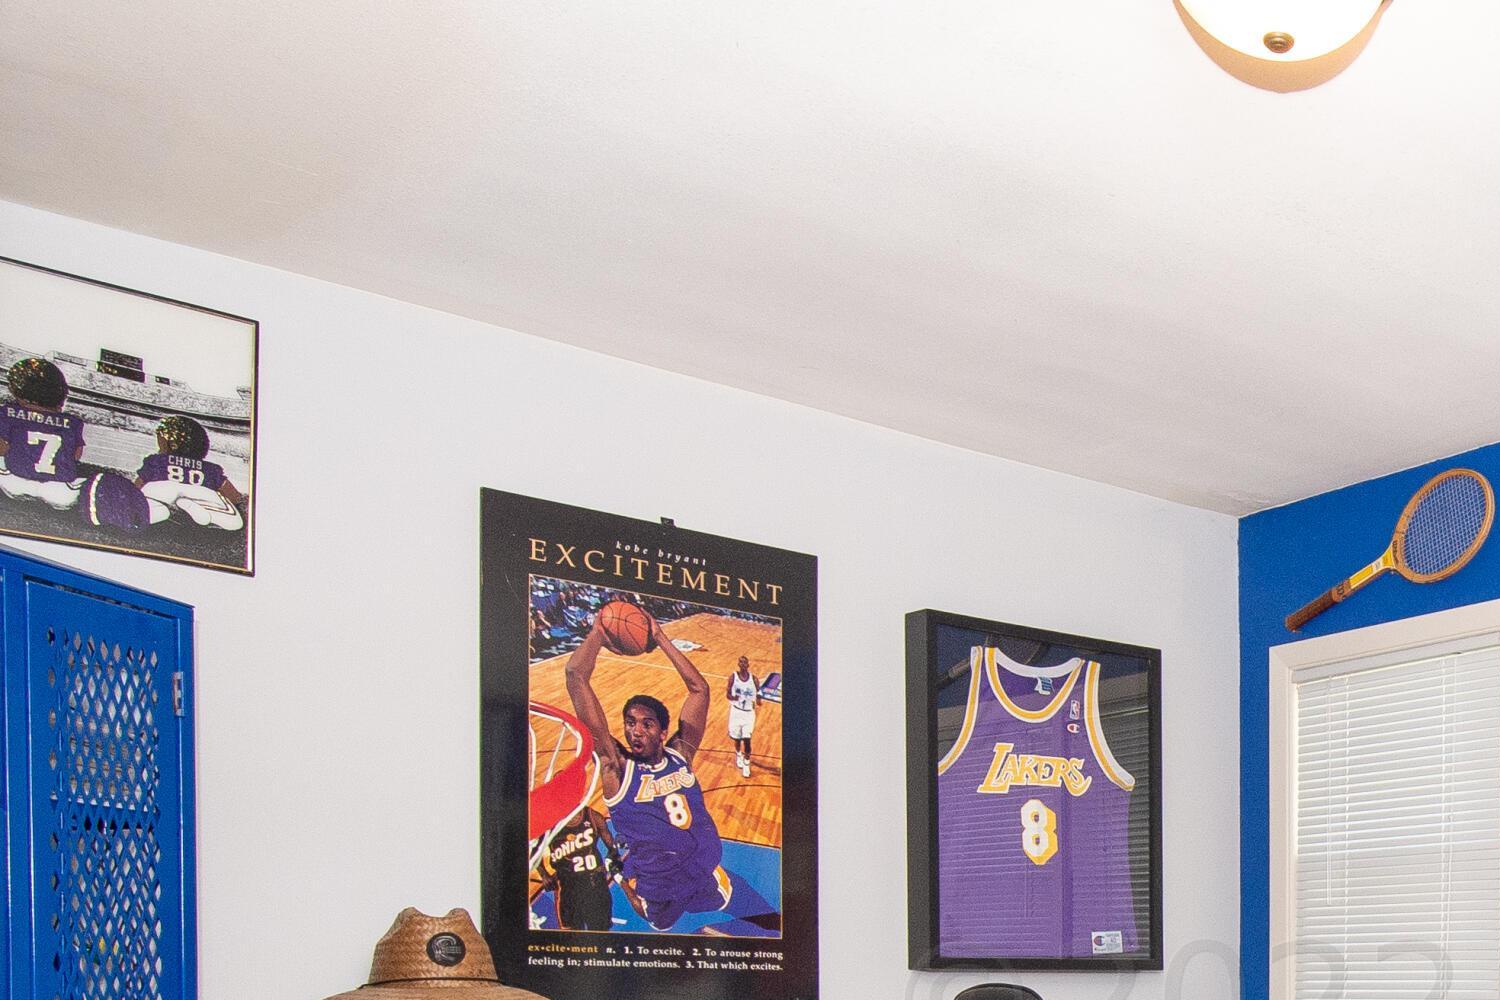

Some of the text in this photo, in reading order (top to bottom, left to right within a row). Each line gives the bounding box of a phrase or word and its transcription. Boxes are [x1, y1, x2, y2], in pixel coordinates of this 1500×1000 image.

[7, 407, 70, 429] RANDALL
[27, 430, 62, 475] 7
[168, 454, 203, 470] CHRIS
[167, 466, 205, 486] 80
[616, 541, 707, 565] kobe bryant
[528, 538, 782, 605] EXCITEMENT
[977, 742, 1092, 797] LAKERS
[634, 766, 696, 803] LAKERS
[664, 793, 693, 830] 8
[551, 828, 594, 862] SONICS
[1021, 799, 1059, 865] 8
[572, 854, 598, 873] 20
[528, 956, 565, 968] feeling
[583, 958, 631, 968] stimulate
[633, 959, 681, 969] emotions.
[685, 960, 695, 969] 3.
[697, 960, 719, 970] That
[720, 961, 749, 970] which
[750, 962, 784, 971] excites.
[637, 946, 650, 955] To
[652, 946, 686, 956] excite.
[692, 947, 702, 957] 2.
[705, 948, 717, 957] To
[720, 950, 752, 958] arouse
[754, 951, 784, 961] strong
